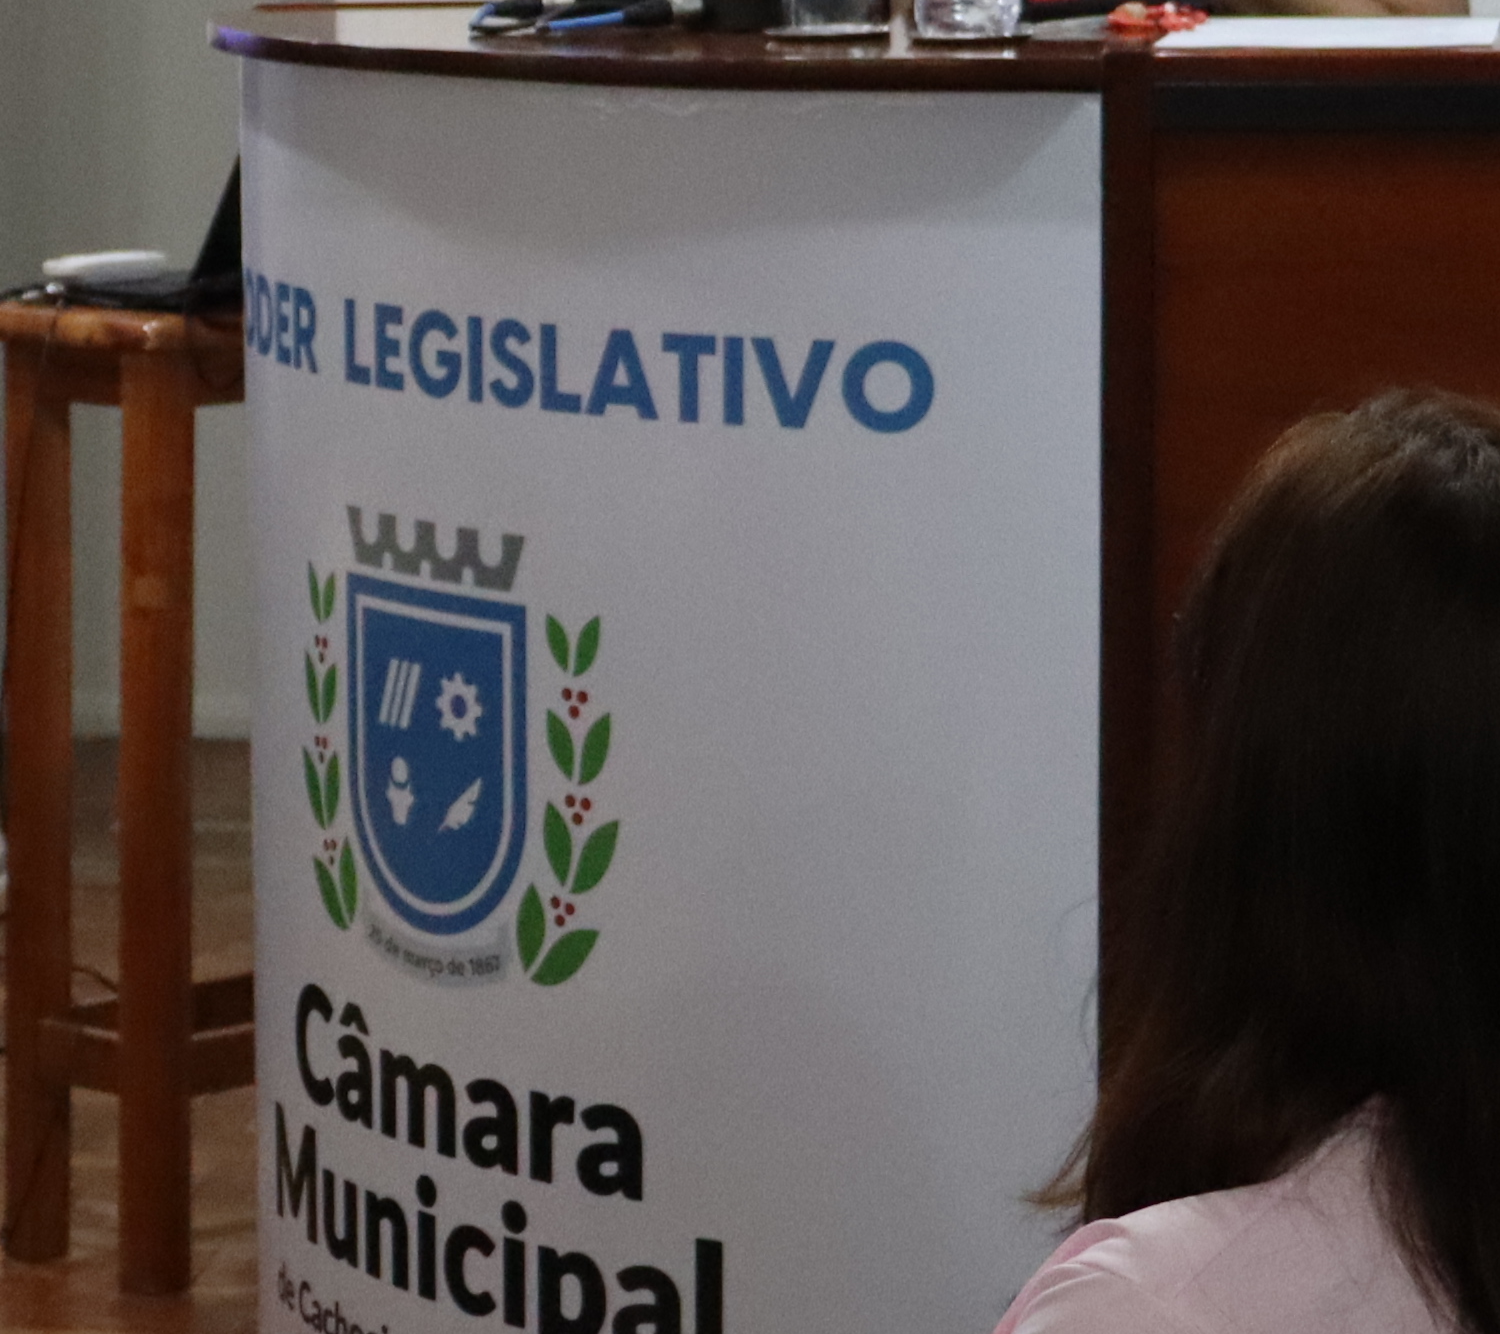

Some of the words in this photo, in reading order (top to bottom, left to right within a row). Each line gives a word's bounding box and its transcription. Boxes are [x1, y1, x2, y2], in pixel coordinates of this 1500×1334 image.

[343, 297, 936, 434] LEGISLATIVO
[295, 983, 643, 1201] Câmara
[278, 1261, 296, 1311] de
